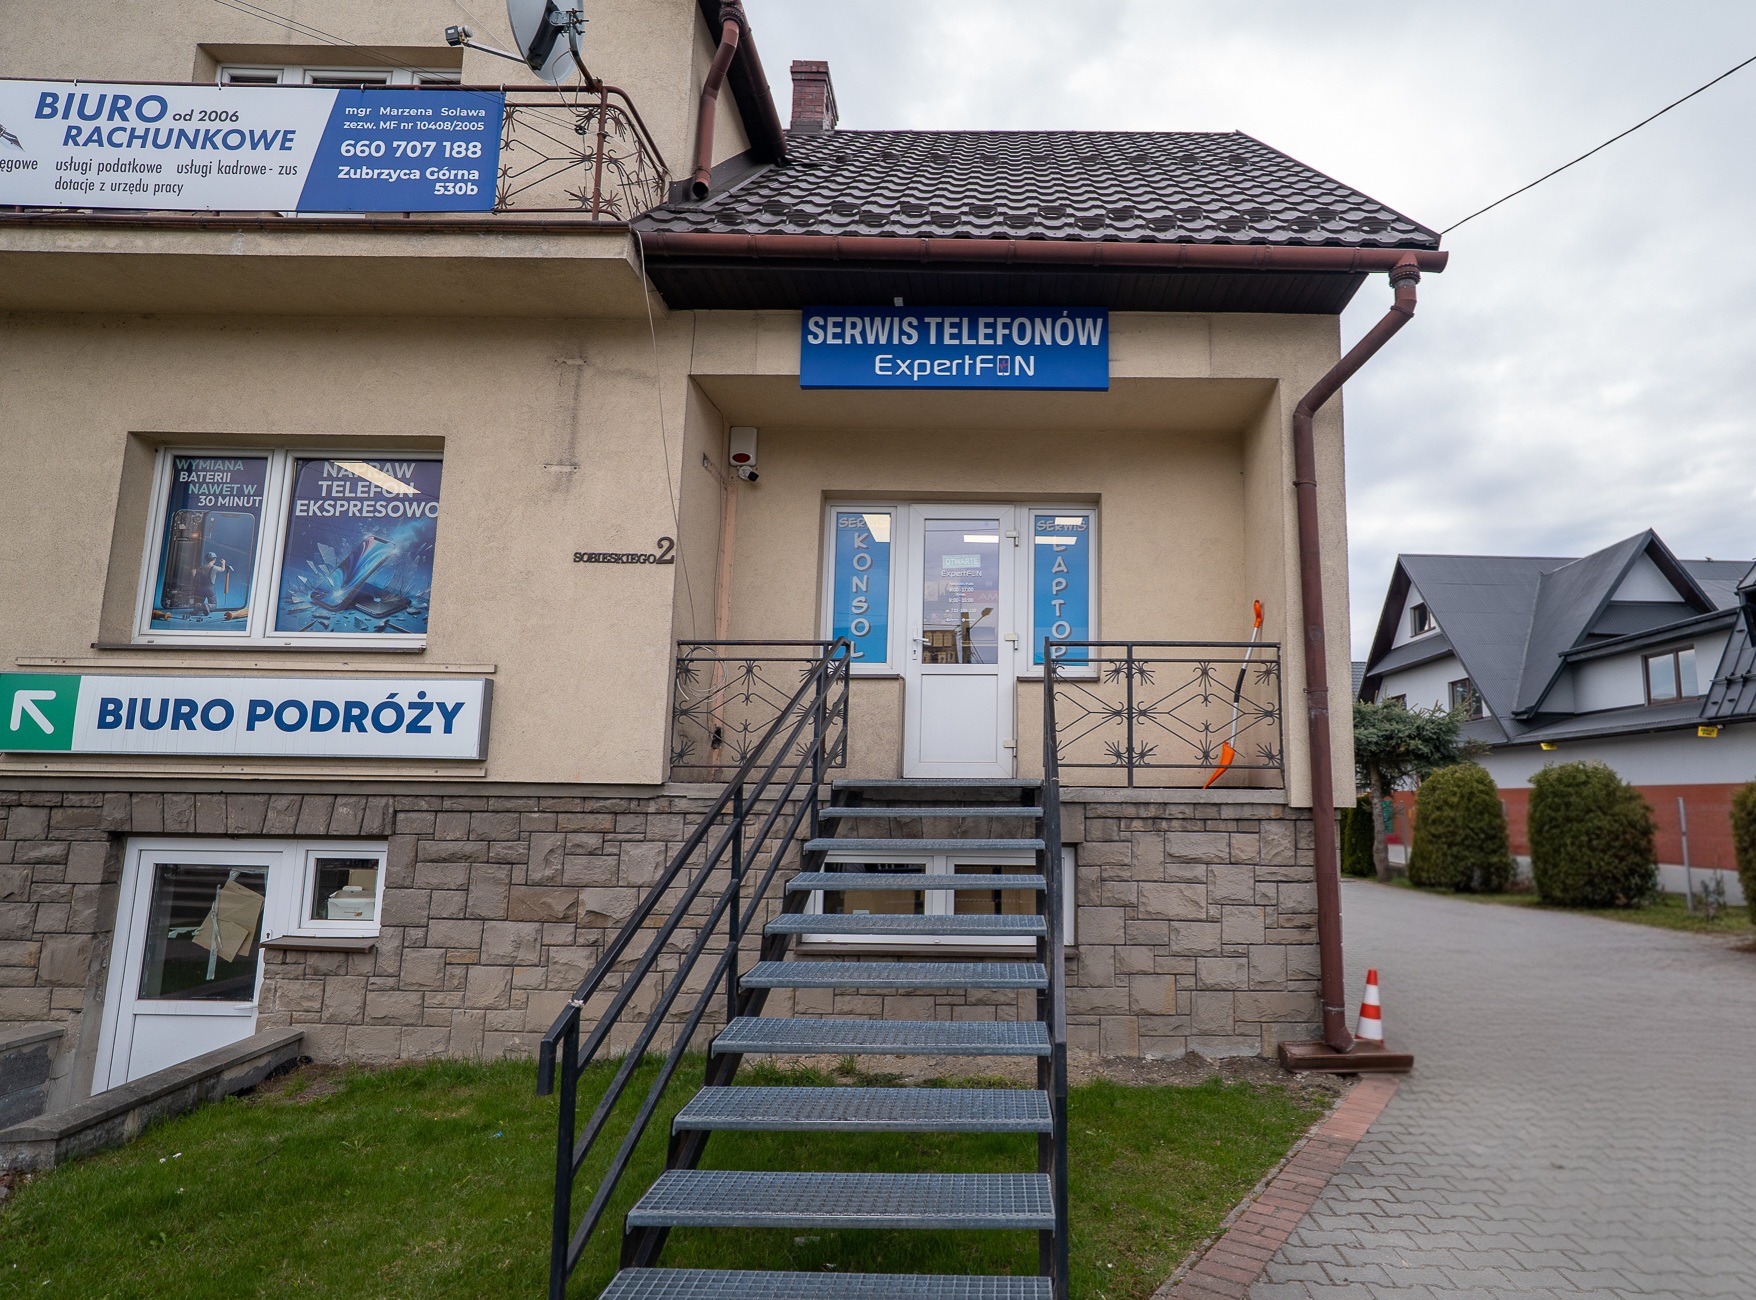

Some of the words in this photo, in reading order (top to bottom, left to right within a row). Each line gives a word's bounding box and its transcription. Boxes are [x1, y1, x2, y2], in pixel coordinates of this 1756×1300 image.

[34, 91, 168, 124] BIURO
[172, 109, 194, 122] od
[197, 110, 240, 122] 2006
[345, 107, 372, 117] mgr
[379, 106, 433, 116] Marzena
[440, 107, 486, 117] Solawa
[343, 121, 377, 130] zezw.
[379, 121, 399, 130] MF
[400, 122, 414, 130] nr
[416, 121, 485, 131] 10408/2005
[62, 125, 297, 151] RACHUNKOWE
[340, 139, 386, 158] 660
[392, 141, 437, 158] 707
[442, 141, 483, 158] 188
[55, 156, 93, 176] usługi
[97, 157, 163, 176] podatkowe
[176, 159, 213, 178] usługi
[278, 165, 298, 176] zus
[337, 166, 421, 182] Zubrzyca
[425, 166, 480, 180] Górna
[54, 176, 95, 195] dotacje
[99, 182, 106, 192] z
[110, 178, 149, 195] urzędu
[153, 183, 184, 197] pracy
[434, 182, 479, 196] 530b
[807, 316, 919, 346] SERWIS
[924, 310, 1104, 346] TELEFONÓW
[175, 458, 245, 471] WYMIANA
[323, 461, 416, 479] NAPRAW
[179, 471, 231, 483] BATERII
[188, 483, 241, 495] NAWET
[243, 484, 258, 495] W
[318, 480, 416, 498] TELEFON
[197, 495, 216, 506] 30
[217, 496, 263, 507] MINUT
[295, 500, 440, 518] EKSPRESOWO
[573, 552, 657, 565] SOBIESKIEGO
[656, 536, 675, 565] 2
[945, 557, 979, 566] OTWARTE
[850, 532, 873, 658] KONSOL
[96, 696, 235, 732] BIURO
[246, 690, 466, 735] PODRÓŻY
